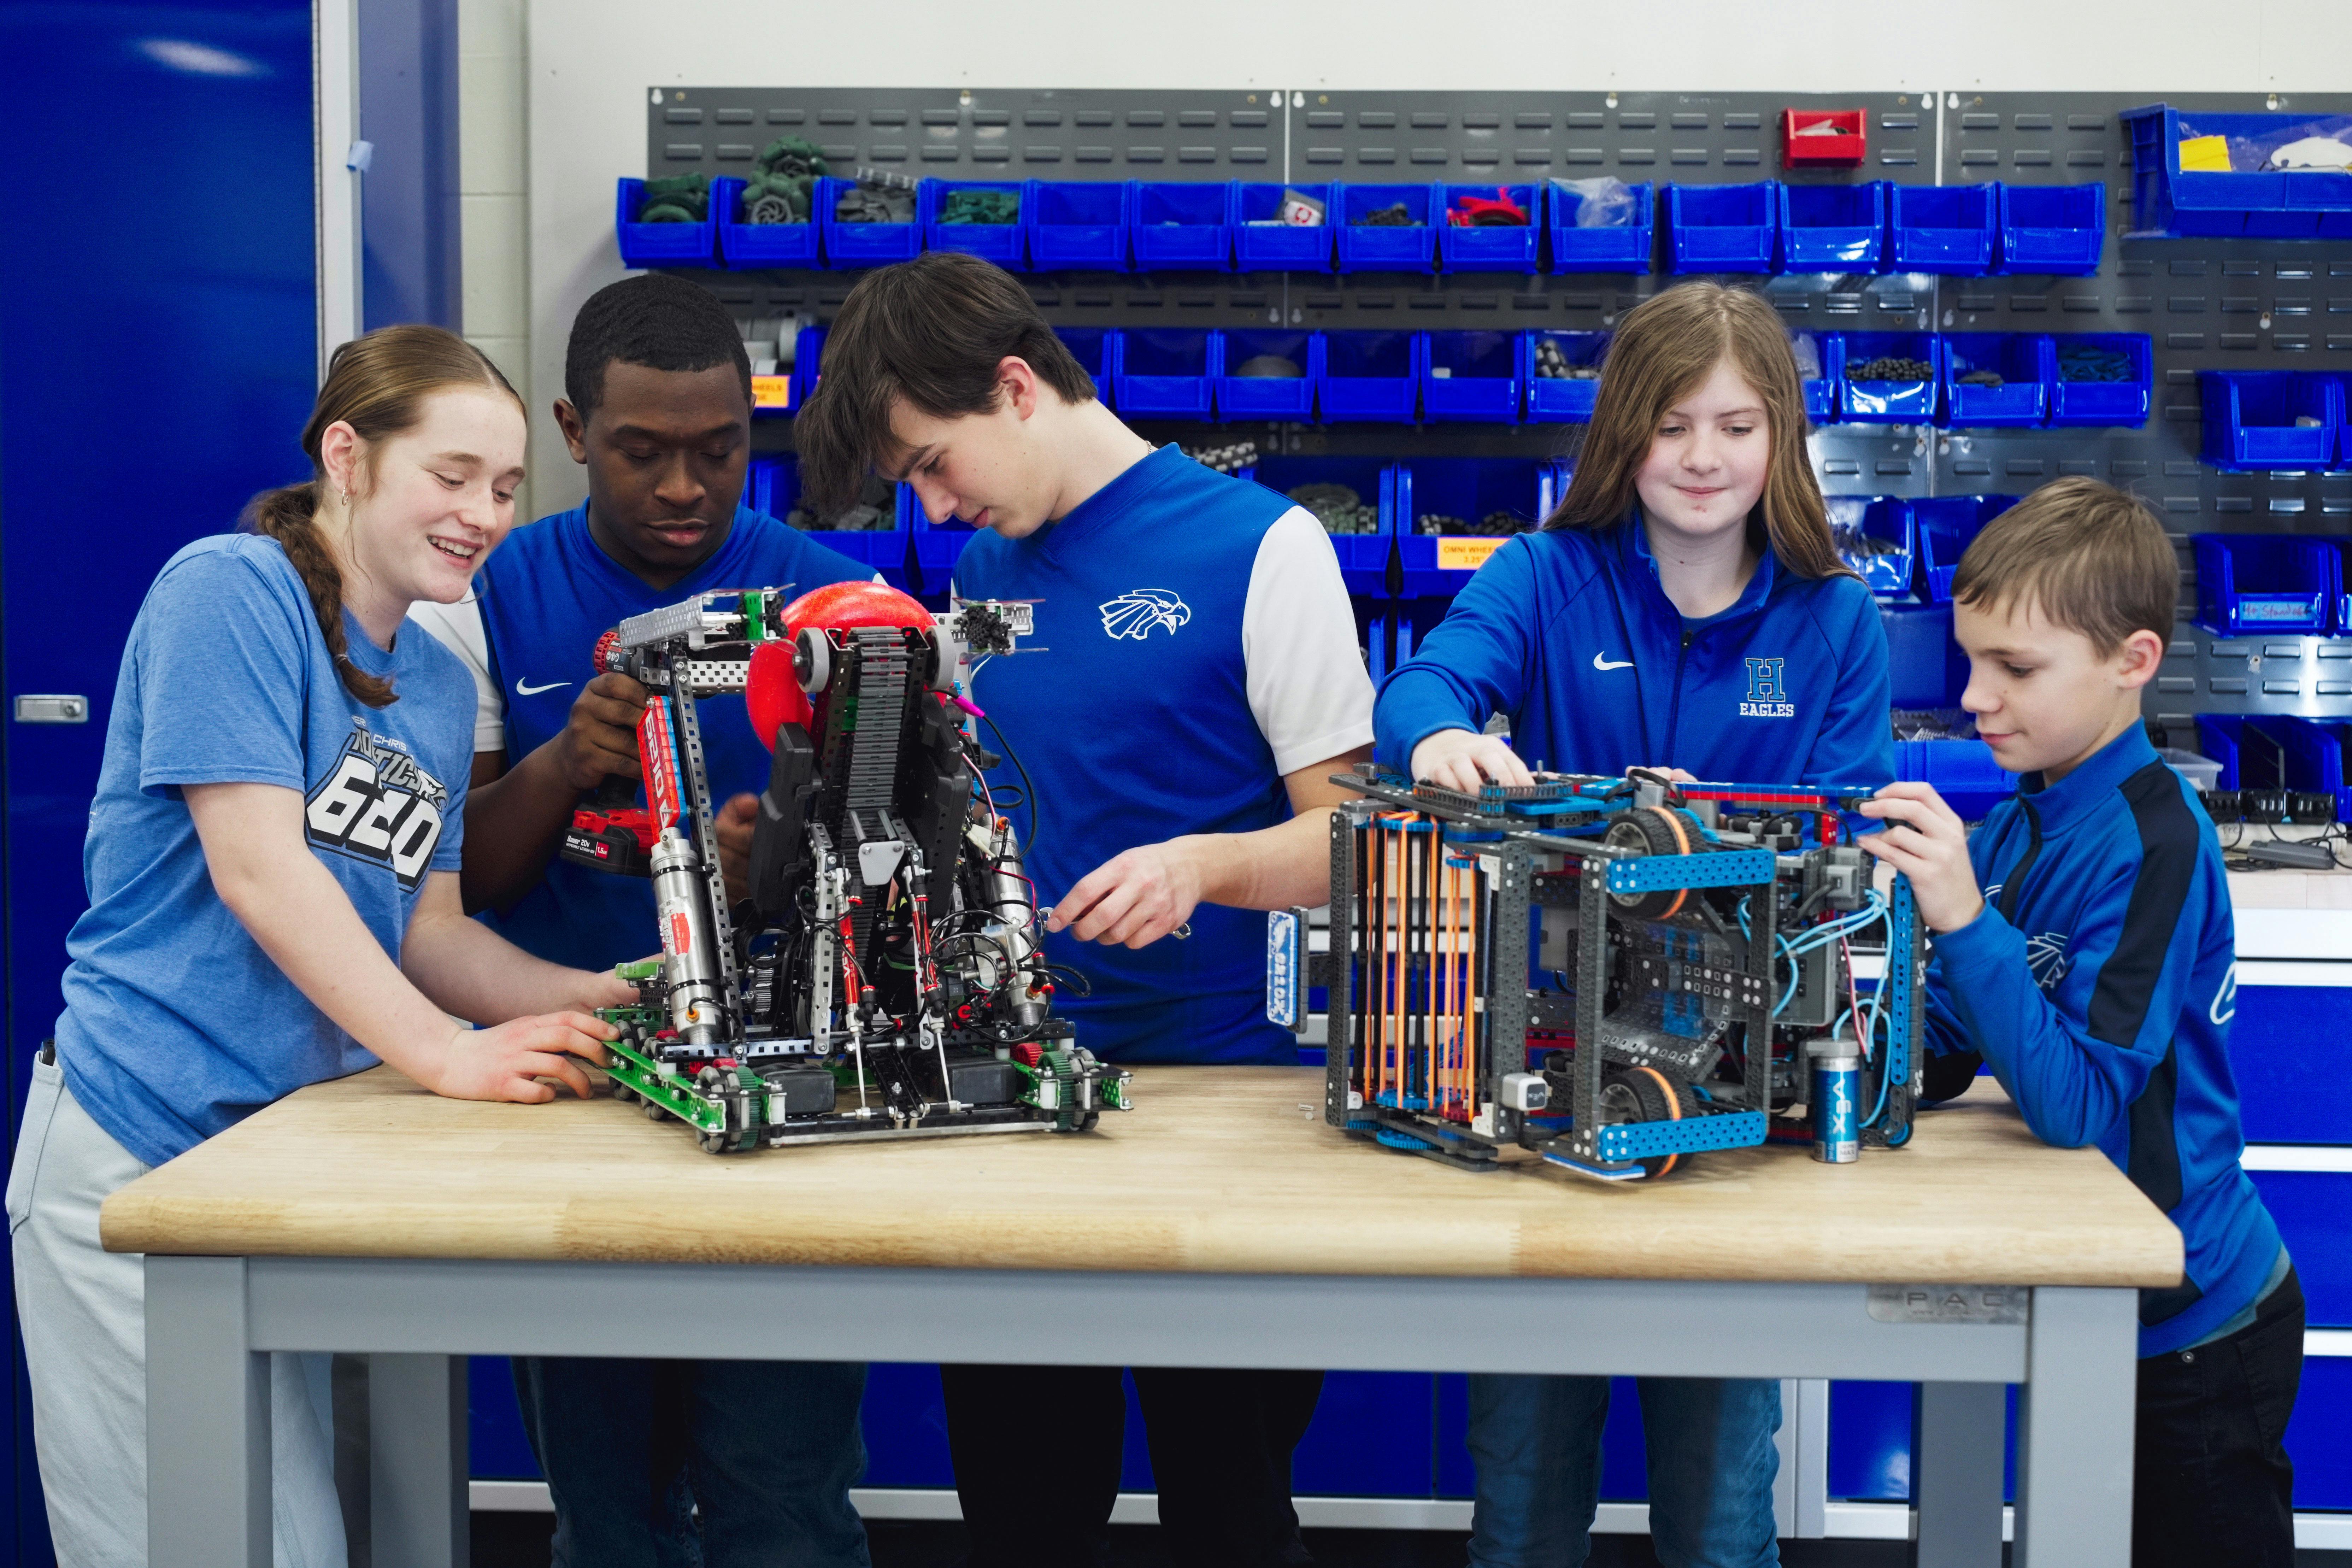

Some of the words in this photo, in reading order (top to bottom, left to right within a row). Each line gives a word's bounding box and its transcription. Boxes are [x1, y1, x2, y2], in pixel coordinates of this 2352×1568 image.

[1468, 546, 1495, 554] WHEE
[1745, 658, 1786, 702] H
[1739, 703, 1794, 717] EAGLES
[645, 710, 664, 798] 6210
[567, 835, 580, 844] Bauer
[1833, 1079, 1852, 1134] VEX
